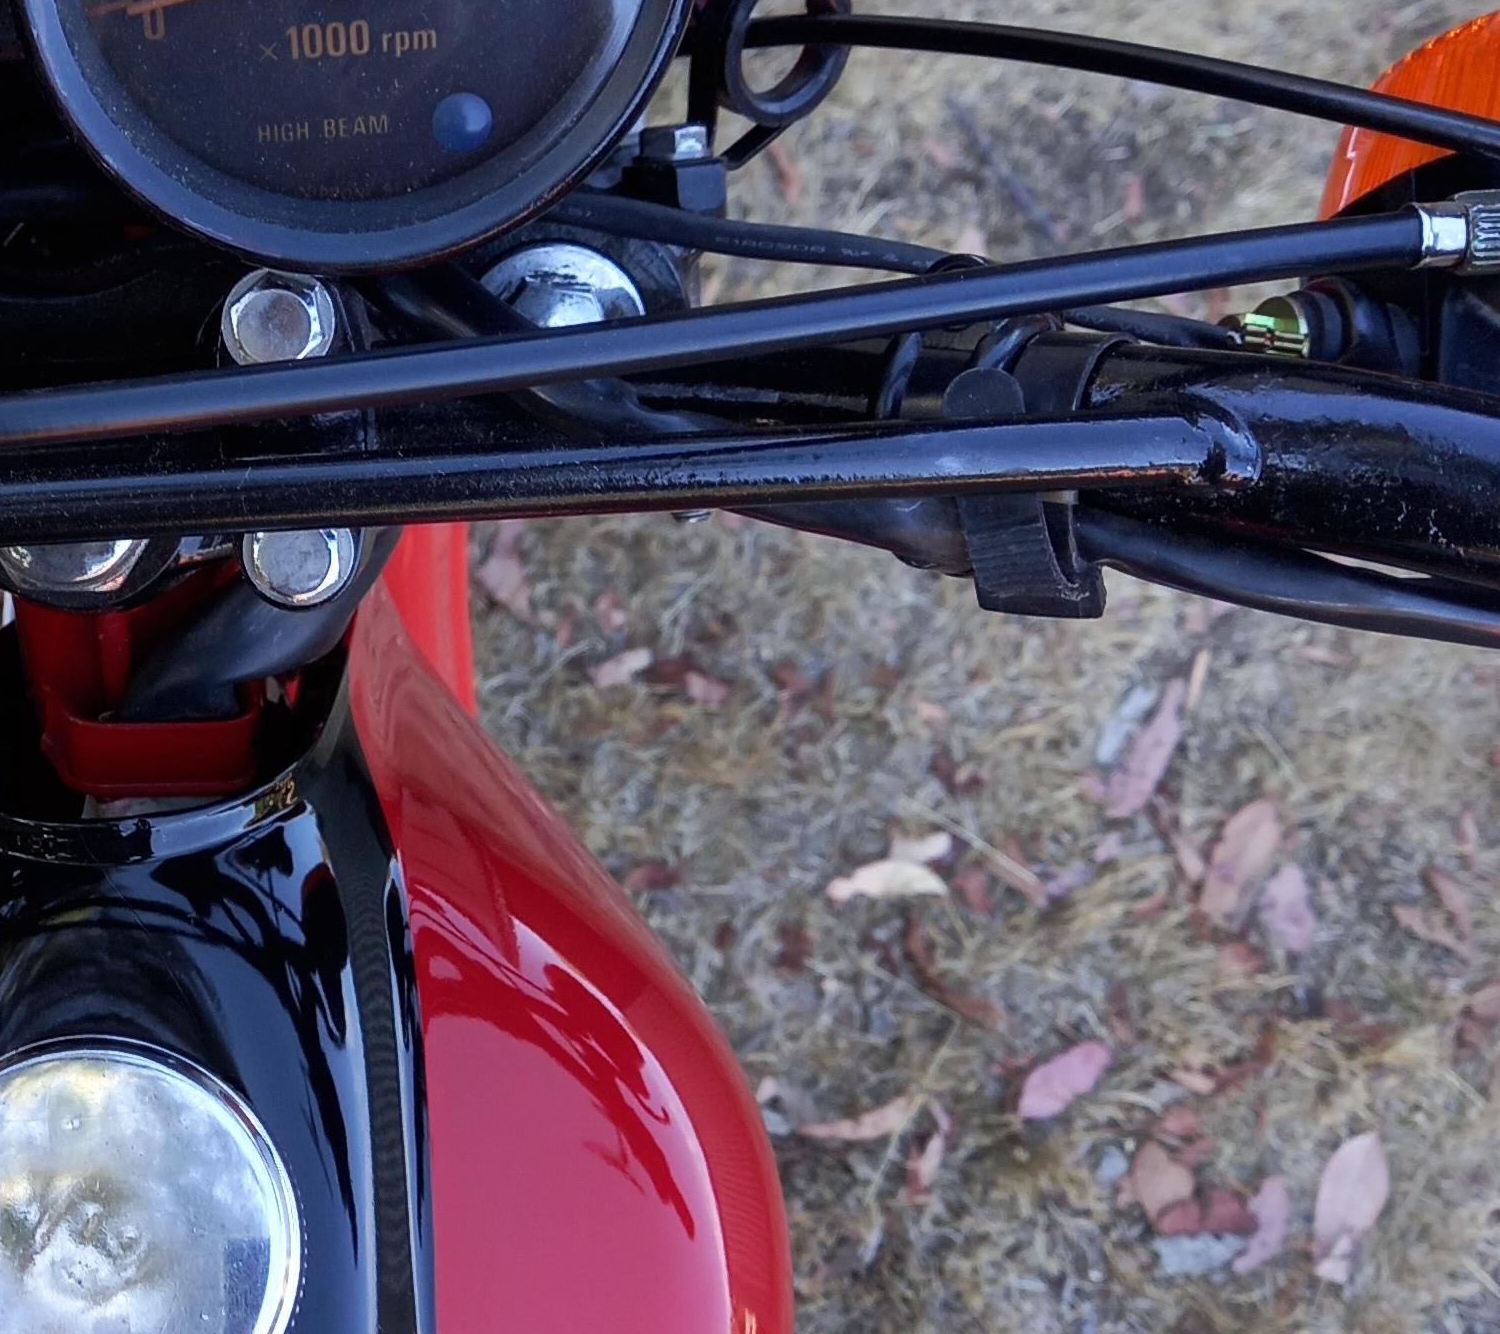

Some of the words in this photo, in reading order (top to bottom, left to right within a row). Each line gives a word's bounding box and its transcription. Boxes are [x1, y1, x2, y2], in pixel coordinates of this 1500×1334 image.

[142, 3, 166, 41] 0
[285, 19, 370, 61] 1000
[380, 27, 438, 56] rpm
[256, 122, 310, 144] HIGH
[323, 114, 389, 139] BEAM
